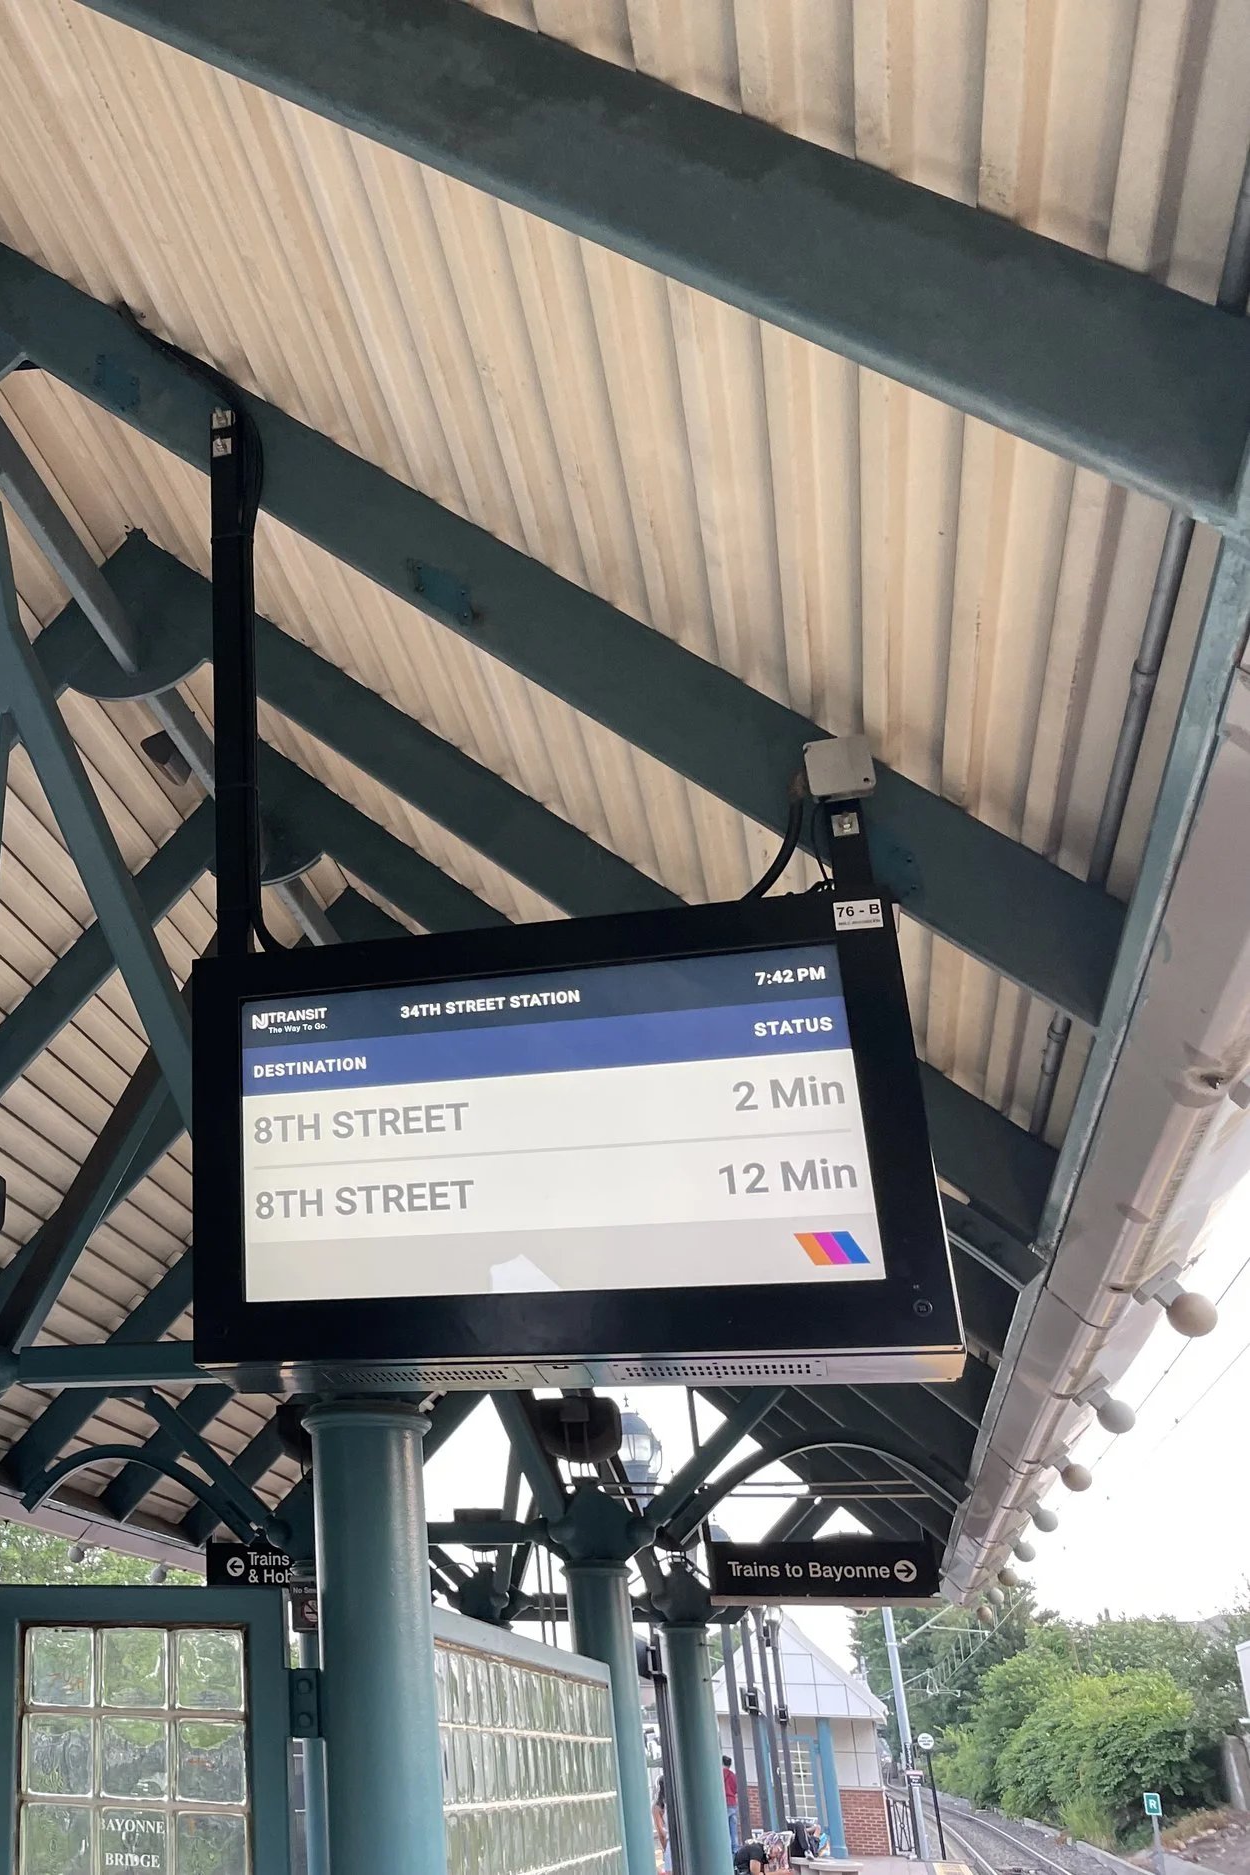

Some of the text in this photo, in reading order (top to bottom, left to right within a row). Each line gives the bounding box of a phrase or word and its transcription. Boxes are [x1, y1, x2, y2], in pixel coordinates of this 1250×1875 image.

[836, 905, 855, 918] 76
[869, 903, 880, 915] B
[755, 966, 826, 986] 7:42 PM
[400, 989, 581, 1019] 34TH STREET STATION
[268, 1026, 283, 1034] The
[284, 1024, 301, 1033] Way
[302, 1023, 313, 1031] To
[754, 1016, 833, 1037] STATUS
[253, 1056, 367, 1078] DESTINATION
[732, 1075, 846, 1112] 2 Min
[254, 1102, 469, 1144] 8TH STREET
[718, 1158, 858, 1195] 12 Min
[255, 1180, 474, 1220] 8TH STREET
[247, 1551, 290, 1566] Trains
[248, 1568, 259, 1583] &
[727, 1561, 890, 1582] Trains to Bayonne
[1148, 1798, 1158, 1810] R
[105, 1852, 161, 1868] BRIDGE
